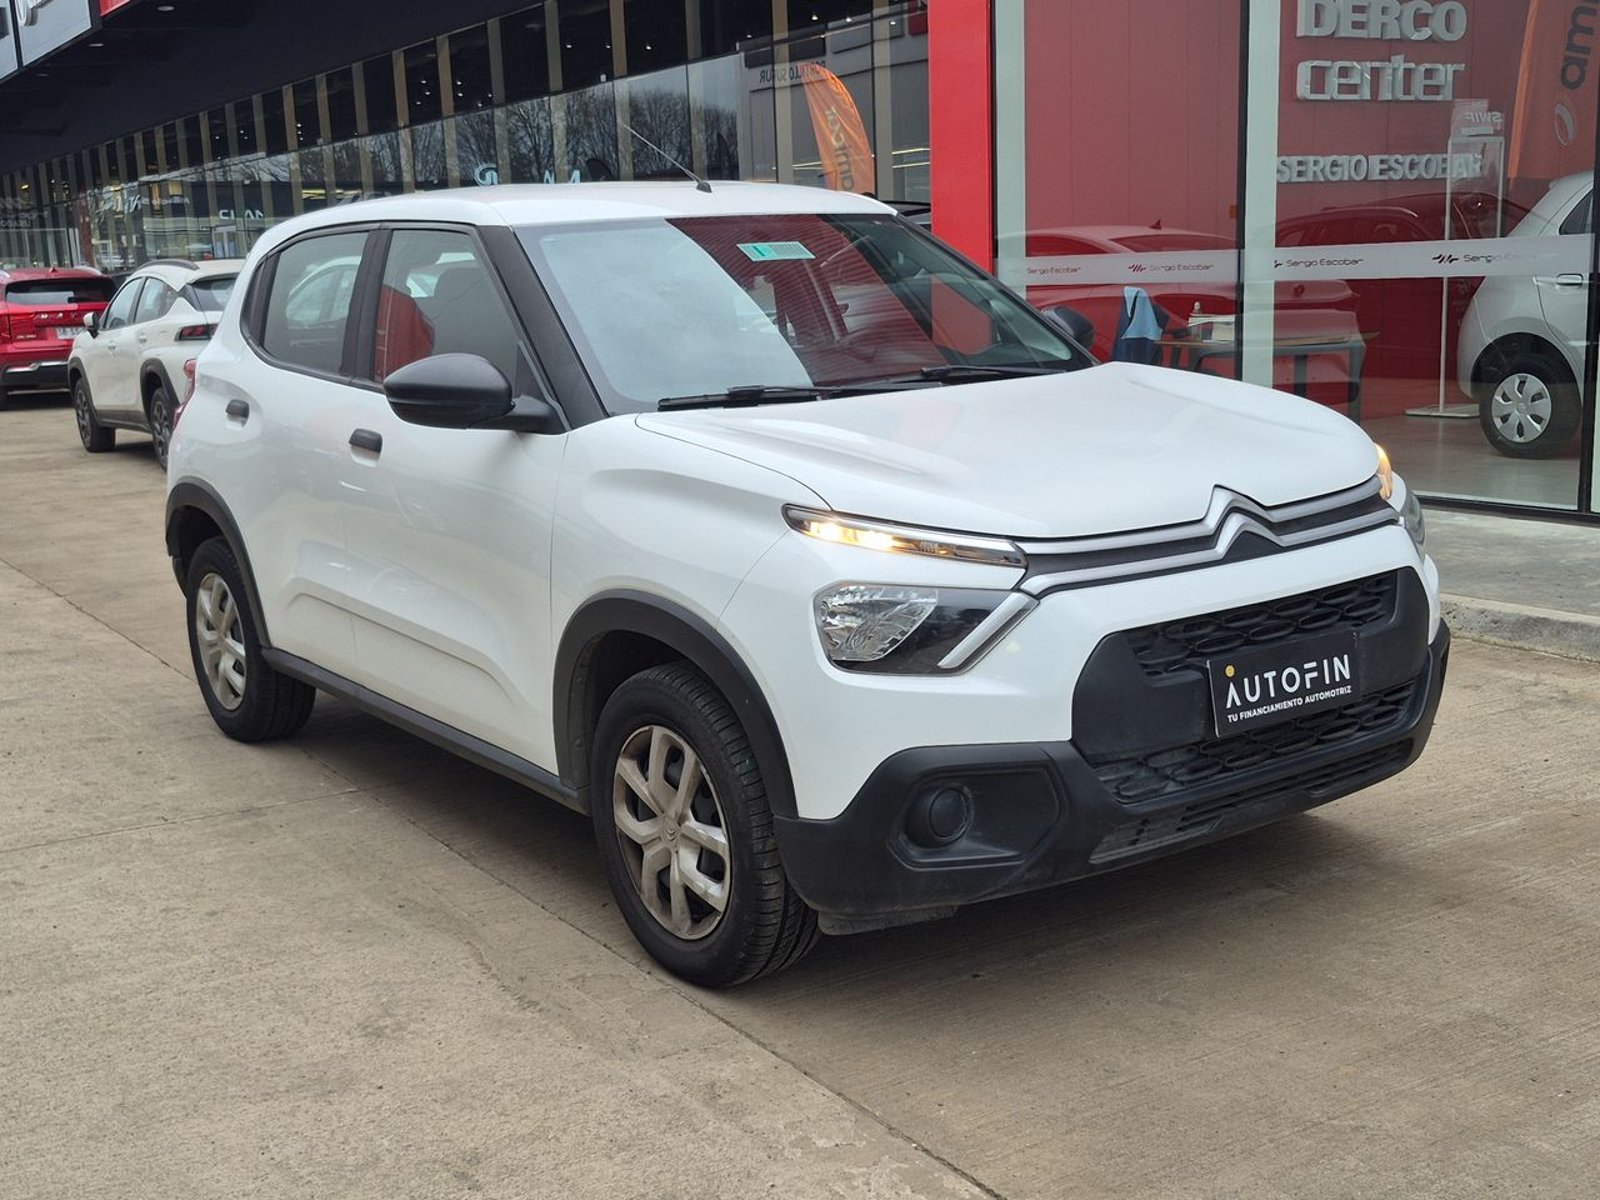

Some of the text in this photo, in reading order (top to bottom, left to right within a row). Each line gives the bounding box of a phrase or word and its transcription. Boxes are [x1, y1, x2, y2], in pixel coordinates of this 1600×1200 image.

[1296, 0, 1467, 41] DERCO
[1296, 55, 1465, 100] center
[1277, 153, 1483, 183] SERGIO ESCOBAR
[1226, 654, 1351, 709] AUTOFIN
[1227, 685, 1353, 723] TU FINANCIAMIENTO AUTOMOTRIZ
